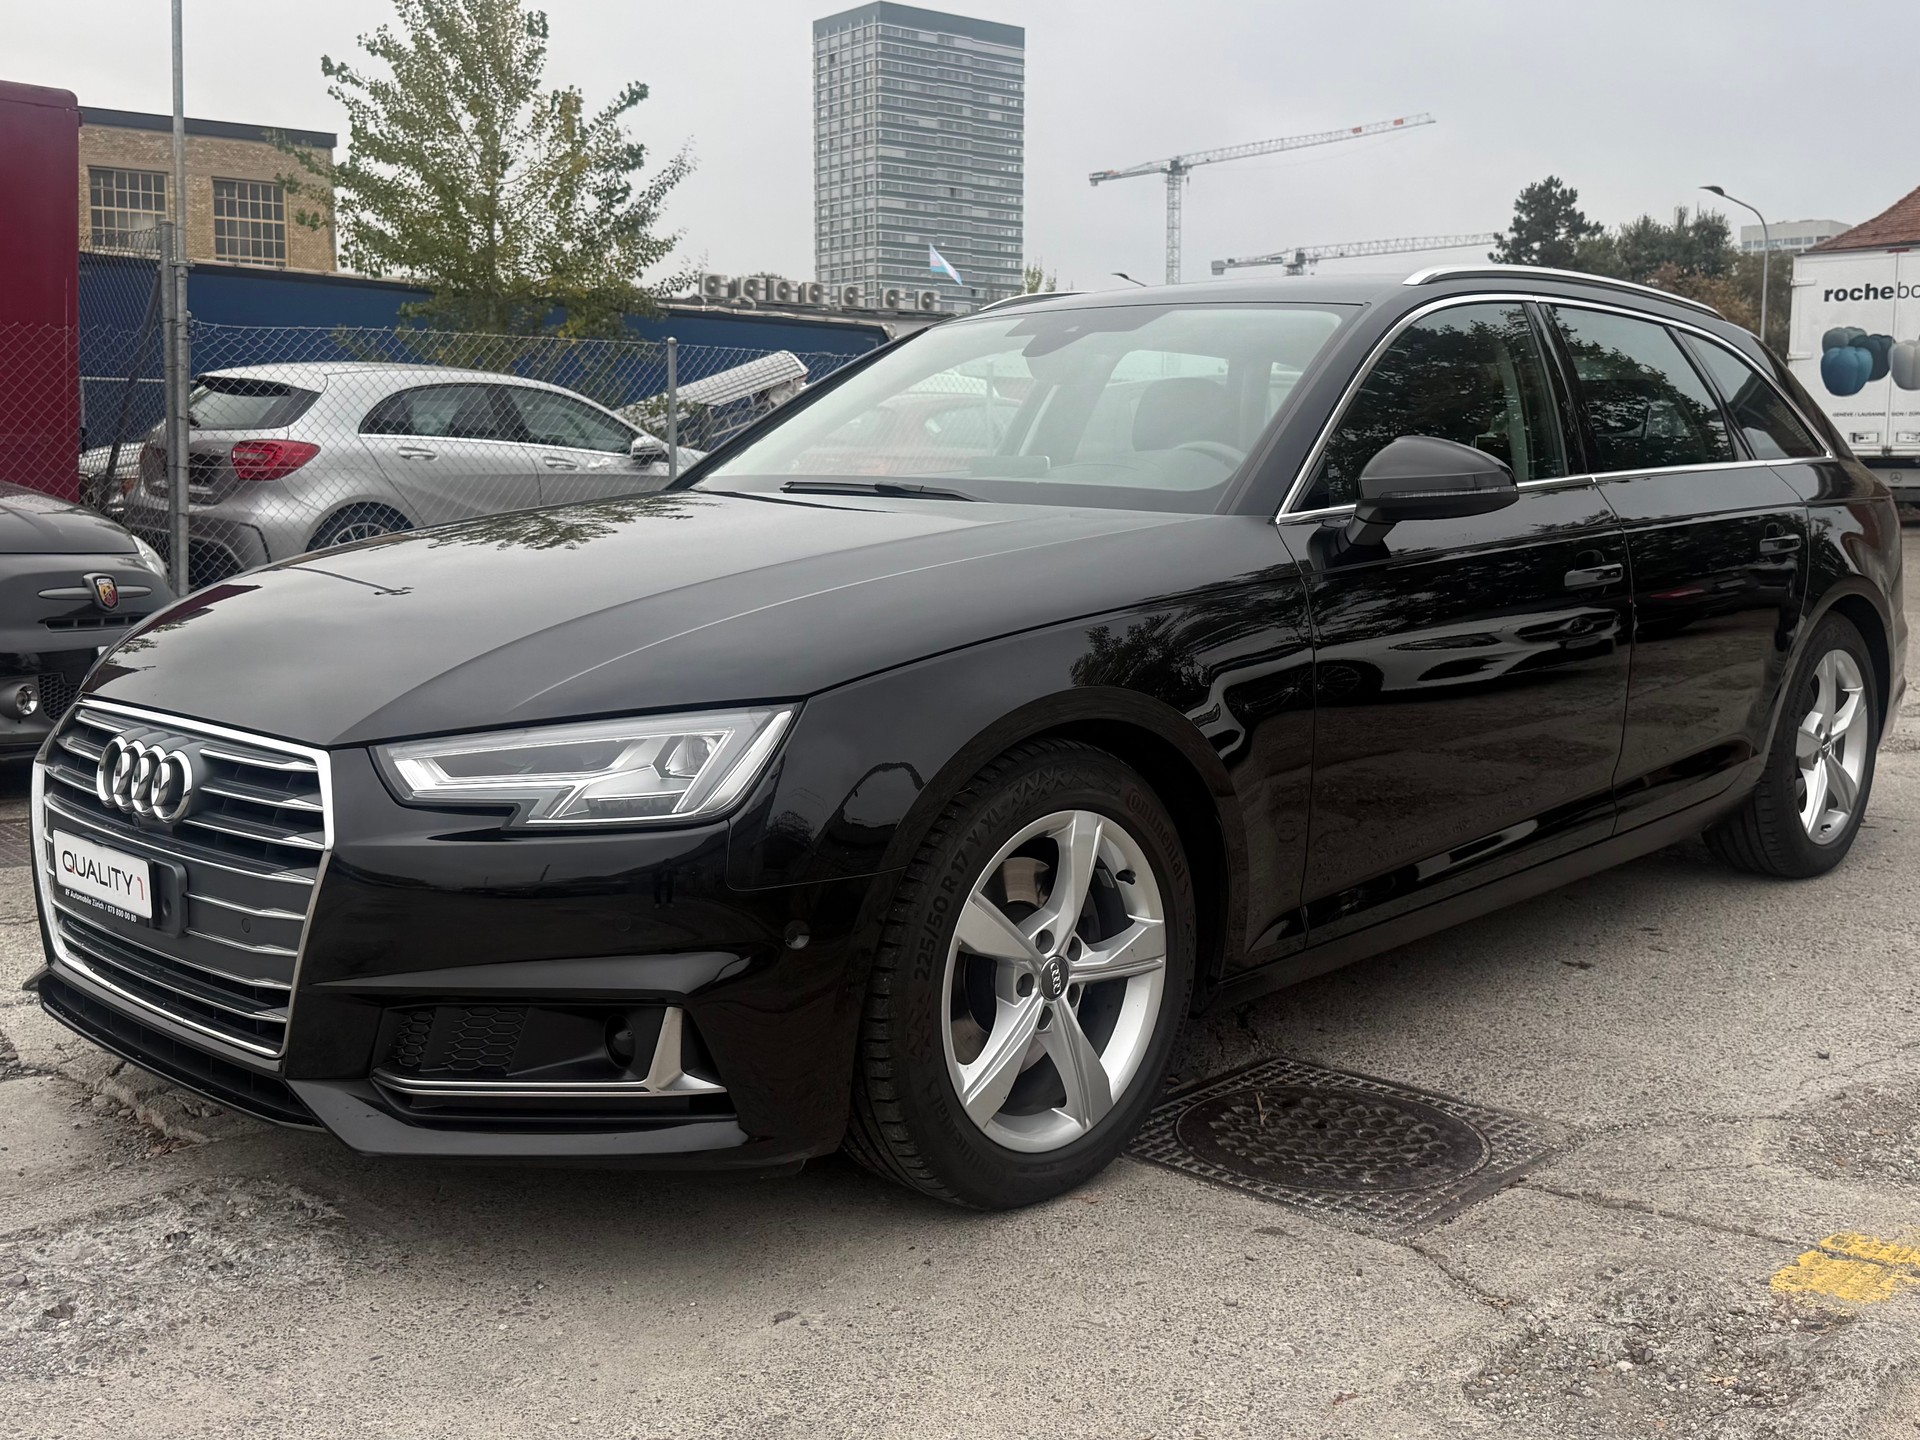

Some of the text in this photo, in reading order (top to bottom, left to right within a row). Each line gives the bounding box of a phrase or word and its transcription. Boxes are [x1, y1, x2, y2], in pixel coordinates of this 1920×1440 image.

[914, 898, 949, 982] 225/50
[941, 875, 958, 894] R
[951, 851, 970, 874] 17
